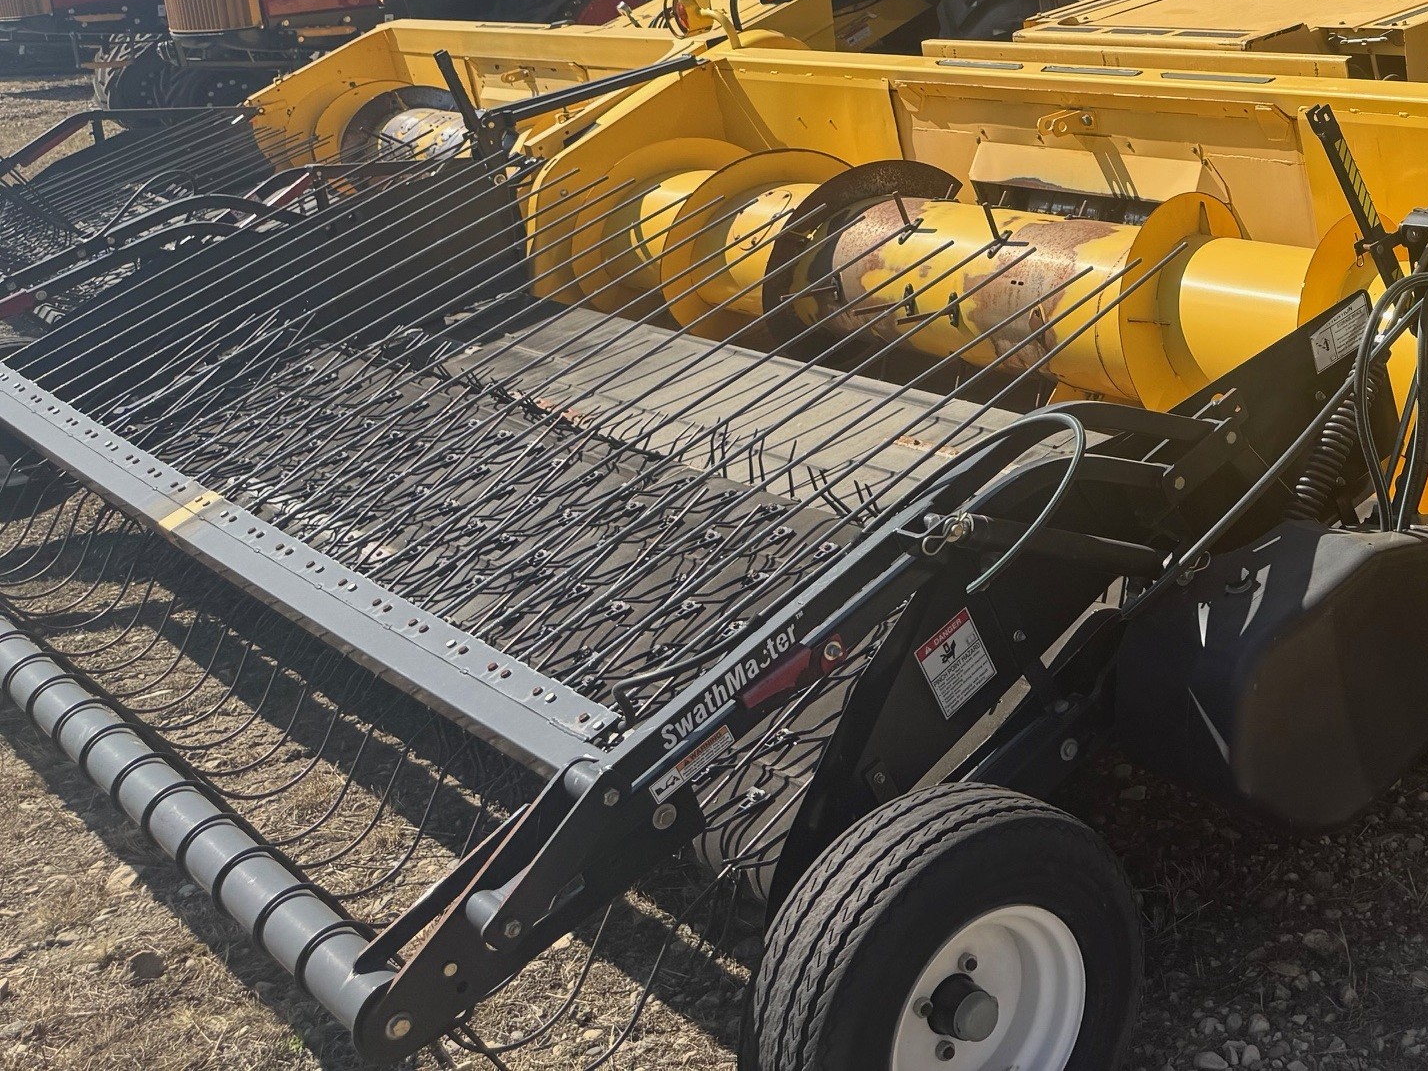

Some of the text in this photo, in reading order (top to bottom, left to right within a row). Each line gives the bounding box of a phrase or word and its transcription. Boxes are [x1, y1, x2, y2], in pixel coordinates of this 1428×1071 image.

[933, 617, 962, 646] DANGER
[947, 659, 962, 675] POINT
[961, 642, 981, 662] HAZARD
[690, 732, 721, 760] WARNING
